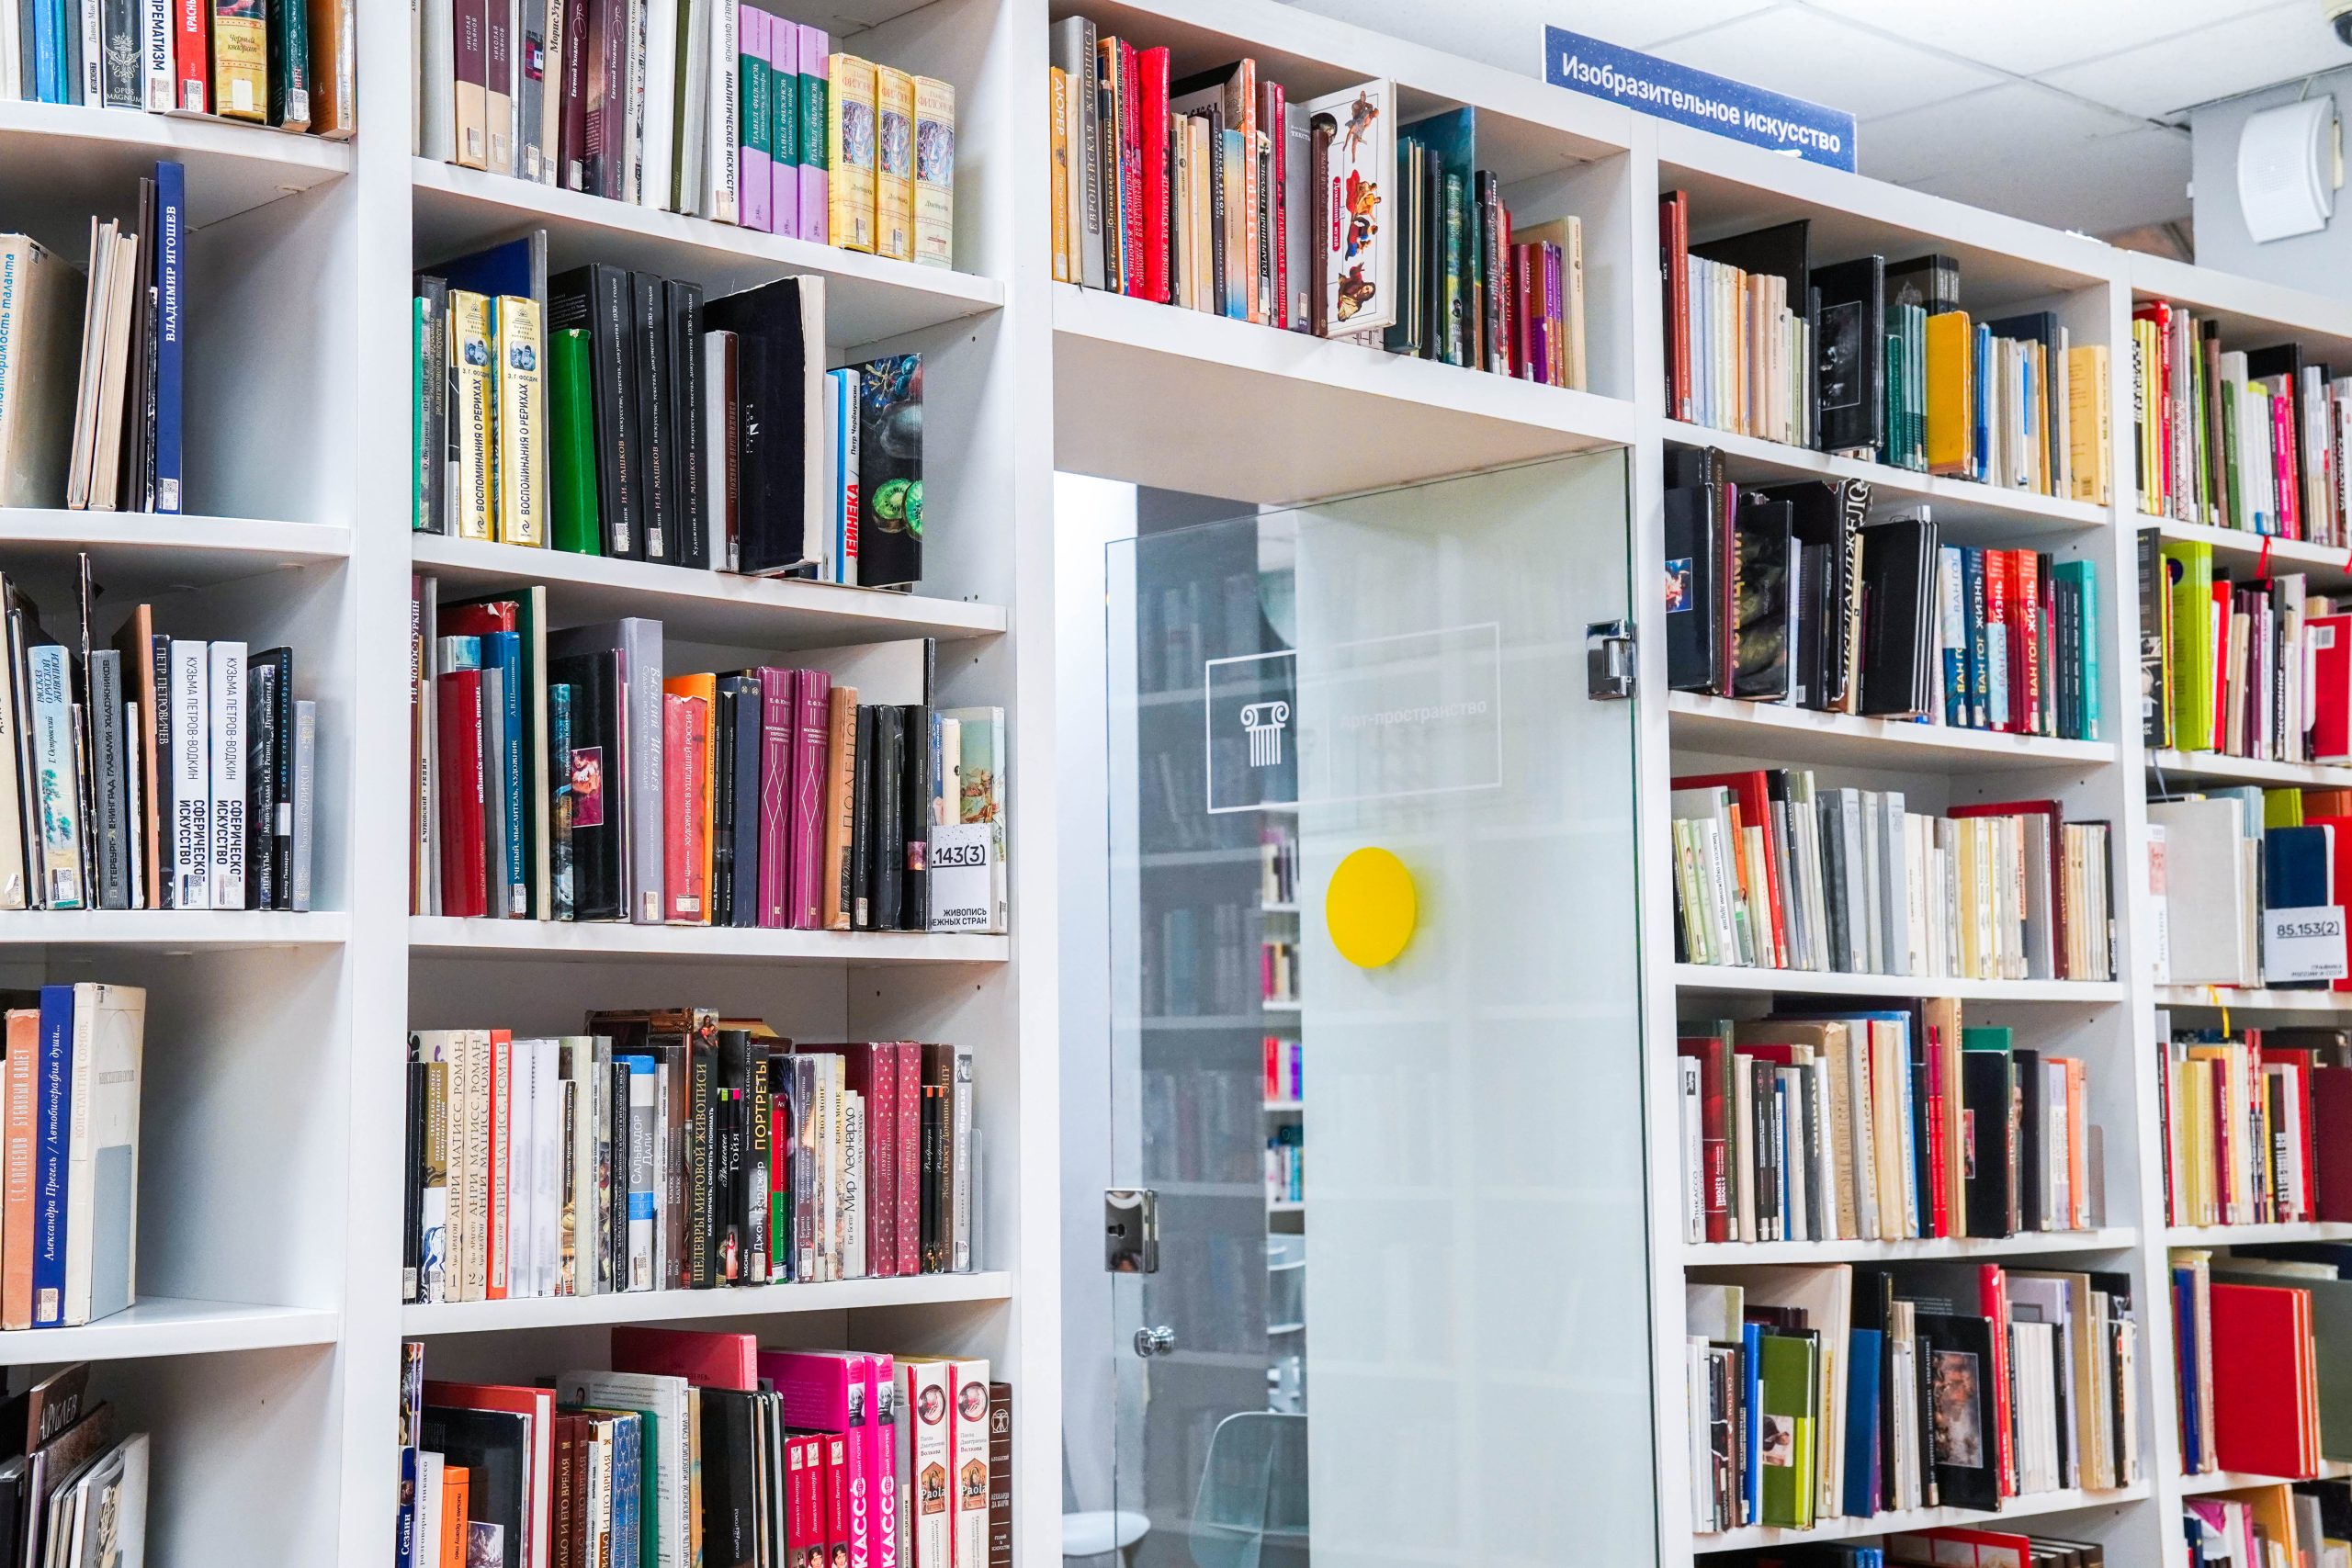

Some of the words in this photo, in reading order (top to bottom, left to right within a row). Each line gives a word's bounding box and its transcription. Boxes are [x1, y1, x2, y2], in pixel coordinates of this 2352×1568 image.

[227, 43, 257, 53] квадрат
[549, 17, 560, 53] Морис
[571, 37, 580, 67] Ухналев
[725, 23, 733, 62] ФИЛОНОВ
[114, 86, 135, 96] OPUS
[570, 67, 579, 97] Евгений
[760, 73, 768, 94] мифы
[1082, 28, 1094, 114] ЖИВОПИСЬ
[107, 93, 141, 103] MAGNUM
[726, 70, 734, 148] АНАЛИТИЧЕСКОЕ
[1055, 76, 1065, 136] ДЮРЕР
[1562, 52, 1740, 125] Изобразительное
[1744, 109, 1841, 152] искусство
[752, 110, 761, 144] ПАВЕЛ
[759, 103, 767, 141] реальность
[1105, 120, 1114, 166] маневры
[1086, 124, 1098, 231] ЕВРОПЕЙСКАЯ
[1106, 168, 1115, 226] Оптические
[1259, 160, 1267, 209] ГЕРКУЛЕС
[165, 206, 175, 267] ИГОШЕВ
[1278, 208, 1286, 269] ИТАЛЬЯНСКАЯ
[2, 254, 15, 310] таланта
[1278, 271, 1286, 319] ЖИВОПИСЬ
[165, 270, 175, 343] ВЛАДИМИР
[434, 318, 443, 359] искусства
[472, 378, 482, 422] РЕРИХАХ
[850, 385, 858, 434] Черёмушкин
[849, 435, 857, 456] Петр
[474, 432, 484, 513] ВОСПОМИНАНИЯ
[1950, 557, 1959, 580] ГОГ
[1951, 582, 1961, 613] ВАН
[1974, 575, 1984, 630] ЖИЗНЬ
[2025, 580, 2036, 632] ЖИЗНЬ
[156, 647, 166, 674] ПЕТР
[1975, 635, 1985, 660] ГОГ
[1996, 629, 2006, 655] ГОГ
[2027, 637, 2037, 663] ГОГ
[36, 670, 44, 703] РАССКАЗ
[42, 658, 52, 695] РУССКОЙ
[51, 653, 62, 704] ЖИВОПИСИ
[102, 659, 113, 728] ХУДОЖНИКОВ
[187, 657, 198, 695] КУЗЬМА
[1955, 662, 1965, 693] ВАН
[1976, 663, 1986, 694] ВАН
[1997, 658, 2007, 688] ВАН
[2028, 666, 2038, 697] ВАН
[157, 677, 169, 745] ПЕТРОВИЧЕВ
[476, 686, 484, 718] татьяна
[45, 715, 55, 756] Островский
[185, 697, 198, 780] ПЕТРОВ-ВОДКИН
[684, 709, 694, 746] РОССИИ
[104, 731, 115, 777] ГЛАЗАМИ
[475, 719, 484, 804] чумакова-кузнецова
[511, 739, 519, 787] ХУДОЖНИК
[684, 746, 694, 792] УШЕДШЕЙ
[842, 705, 858, 828] ПОЛЕНОВ
[179, 799, 191, 865] ИСКУССТВО
[1712, 832, 1721, 861] Пикассо
[1715, 866, 1724, 905] окружении
[944, 908, 987, 917] ЖИВОПИСЬ
[963, 917, 987, 926] СТРАН
[2277, 920, 2340, 936] 85.153(2)
[50, 1024, 62, 1059] души...
[14, 1048, 30, 1078] ВАЛЕТ
[454, 1041, 464, 1095] РОМАН
[941, 1065, 950, 1094] ЭНГР
[48, 1061, 62, 1144] Автобиография
[754, 1060, 767, 1151] ПОРТРЕТЫ
[942, 1098, 950, 1143] Доминик
[958, 1088, 967, 1134] Моризо
[1811, 1076, 1819, 1158] ТИЦИАН
[642, 1133, 653, 1167] ДАЛИ
[729, 1133, 741, 1171] Гойя
[843, 1107, 856, 1176] Леонардо
[924, 1129, 933, 1173] Рембрандт
[942, 1145, 950, 1174] Огюст
[958, 1136, 967, 1171] Берта
[46, 1156, 58, 1197] Прегель
[451, 1175, 461, 1218] АНРИ
[693, 1147, 706, 1213] МИРОВОЙ
[753, 1161, 766, 1215] Бёрджер
[843, 1180, 857, 1213] Мир
[942, 1176, 950, 1200] Жан
[44, 1200, 58, 1261] Александра
[694, 1216, 706, 1282] ШЕДЕВРЫ
[753, 1218, 764, 1252] Джон
[561, 1457, 570, 1497] ВРЕМЯ
[922, 1487, 945, 1499] Paola
[561, 1498, 570, 1521] ЕГО
[401, 1514, 412, 1556] Сезанн
[419, 1513, 427, 1566] разговоры
